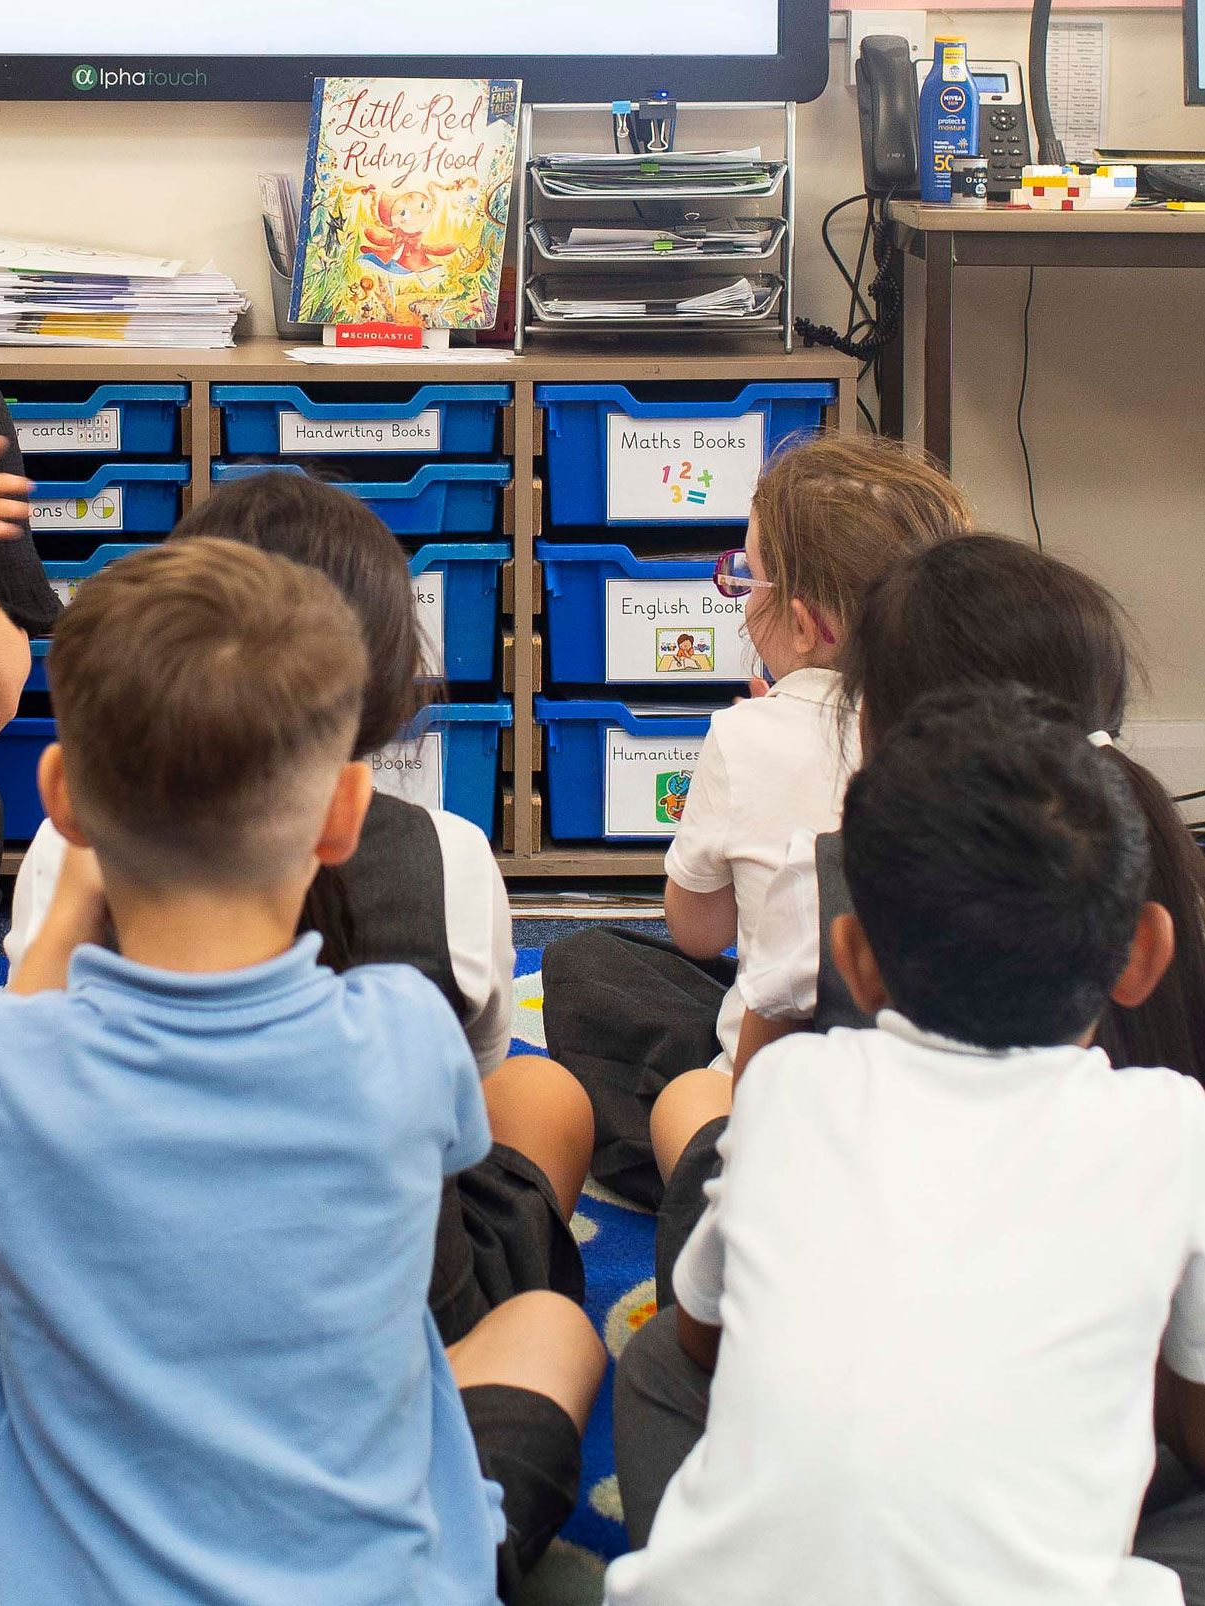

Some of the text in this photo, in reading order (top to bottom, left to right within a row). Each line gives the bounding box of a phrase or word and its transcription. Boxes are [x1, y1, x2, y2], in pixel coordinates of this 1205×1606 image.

[491, 91, 515, 102] FAIRY
[329, 88, 483, 141] Little Red
[938, 117, 961, 126] protect
[341, 140, 484, 188] Riding Hood
[350, 332, 413, 340] SCHOLASTIC
[32, 421, 74, 436] cards
[296, 424, 431, 442] Handwriting Books
[621, 430, 746, 449] Maths Books
[662, 461, 692, 483] 1 2
[670, 485, 682, 503] 3
[622, 596, 743, 620] English Book
[371, 753, 422, 770] Books
[613, 746, 700, 761] Humanities
